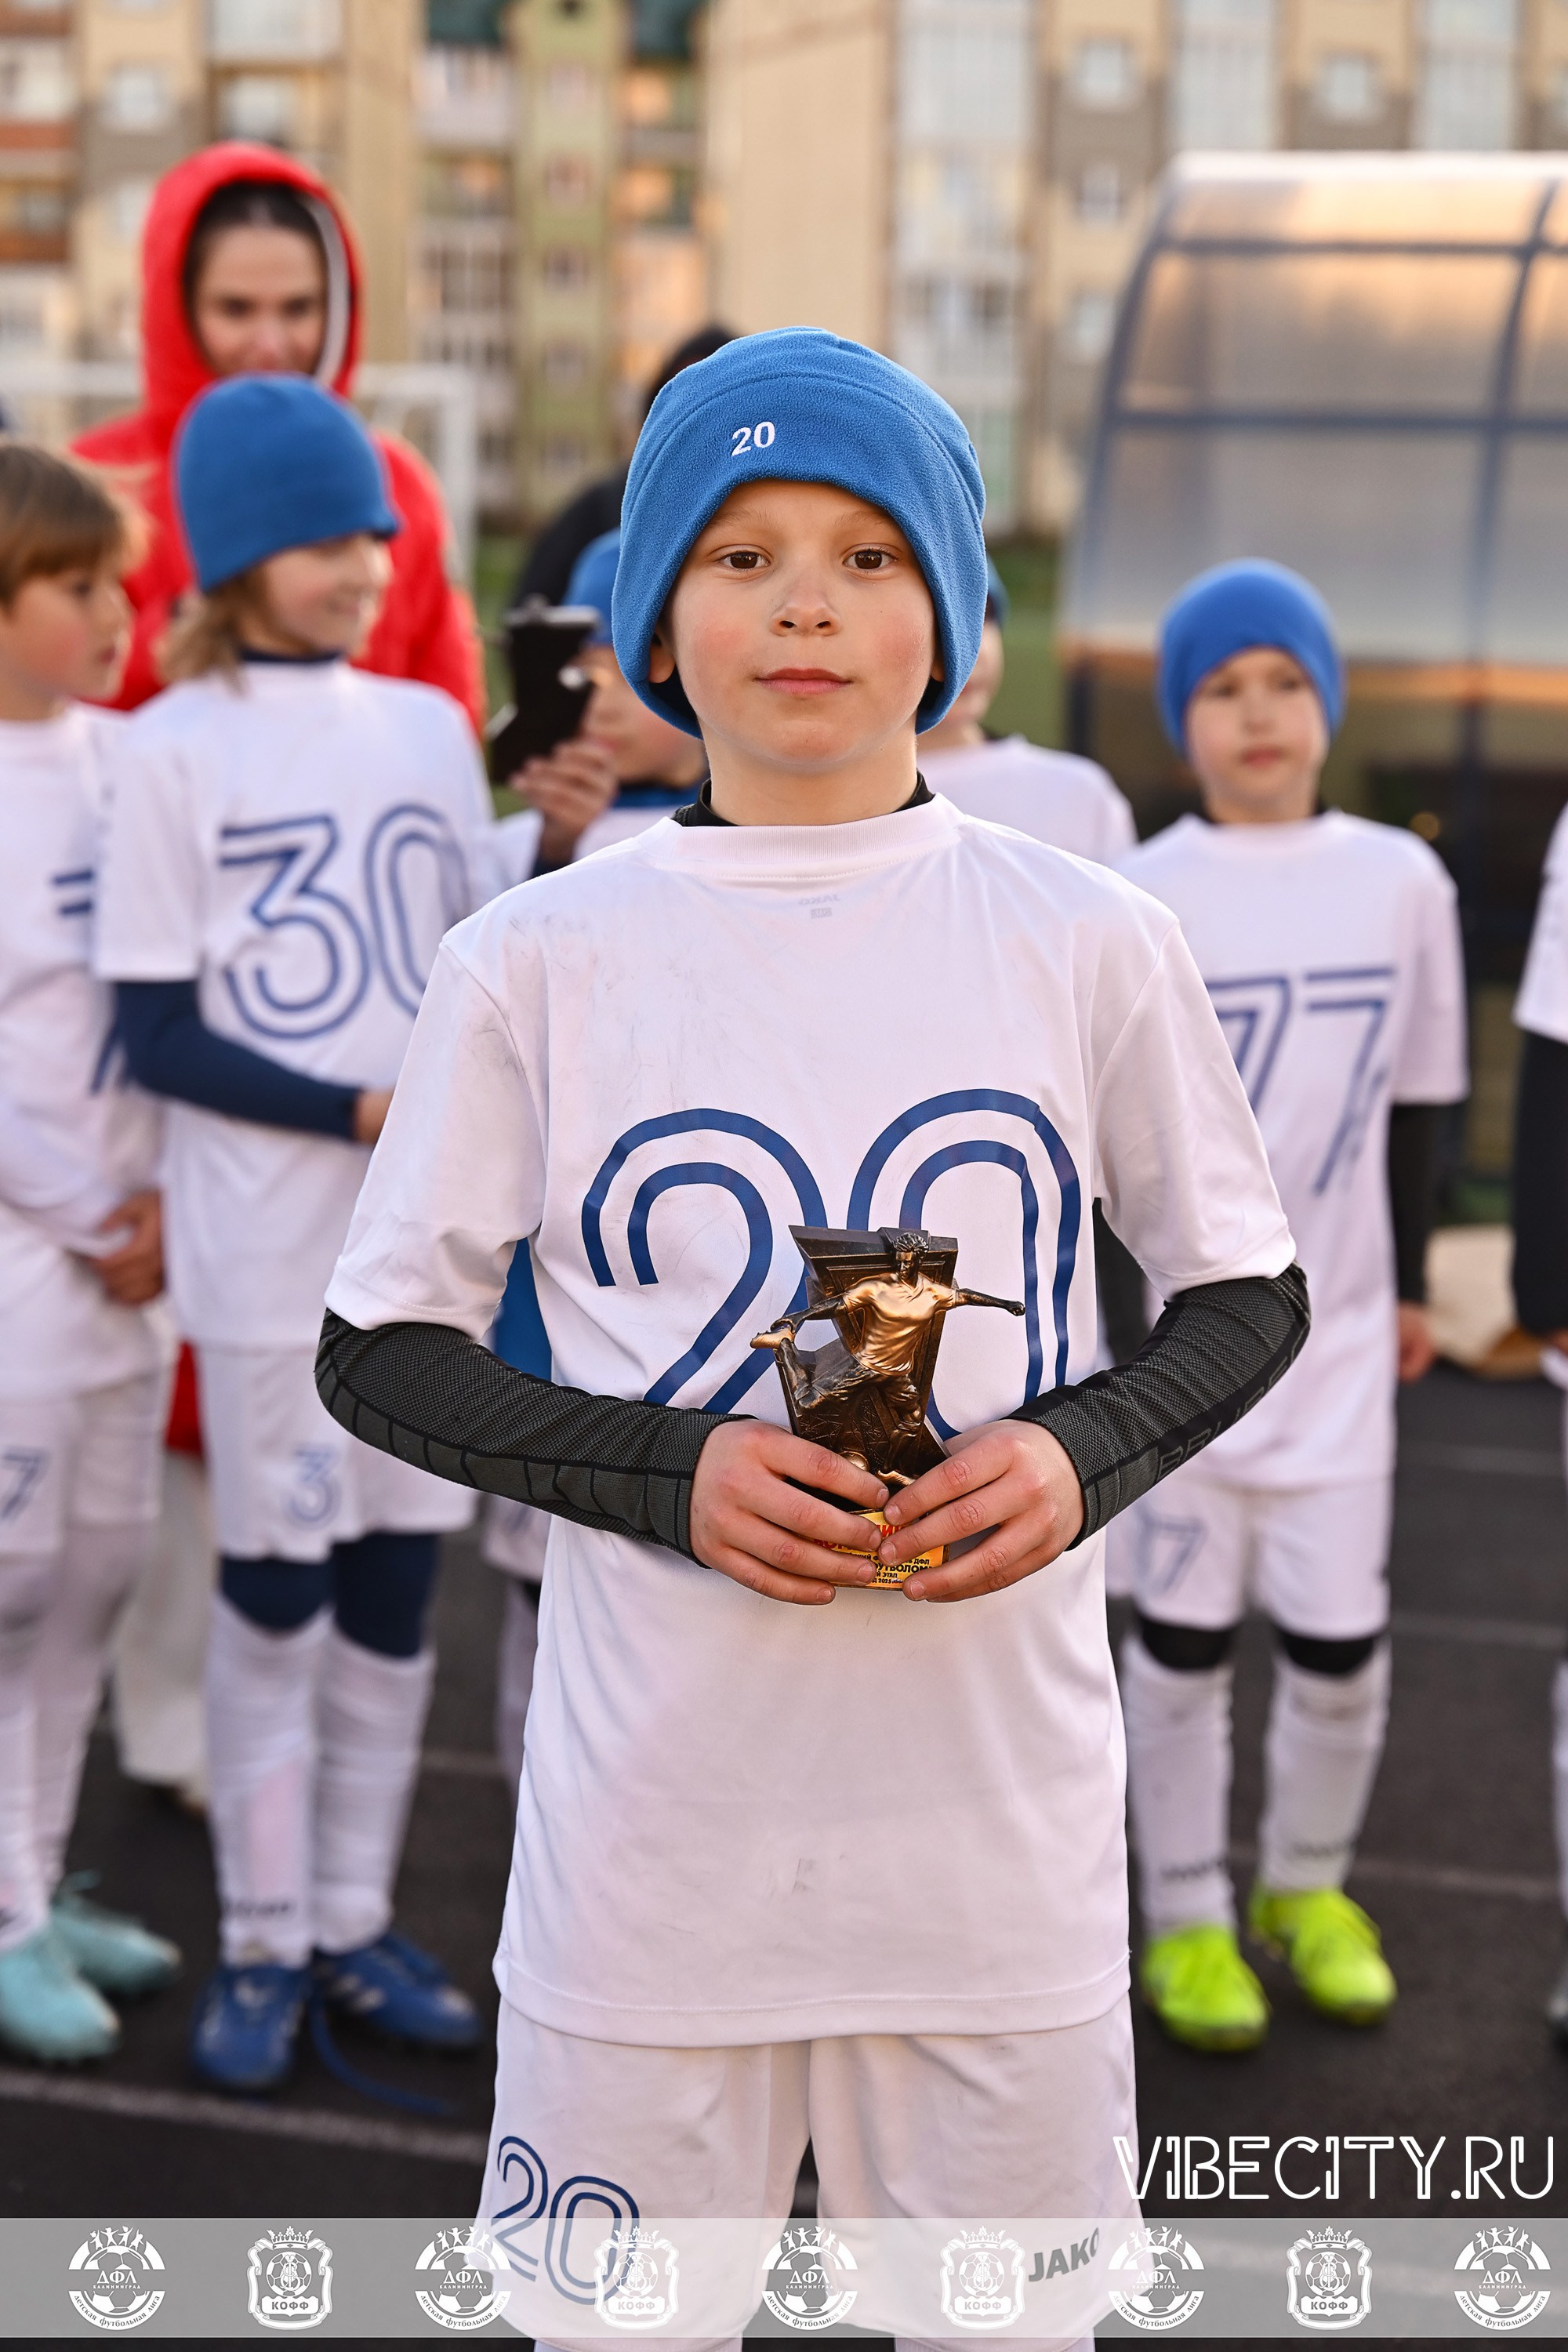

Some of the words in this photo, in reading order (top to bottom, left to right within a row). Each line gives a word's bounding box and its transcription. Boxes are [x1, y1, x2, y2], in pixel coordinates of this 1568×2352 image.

[731, 421, 775, 456] 20
[218, 803, 472, 1040] 30
[582, 1088, 1082, 1439] 20
[492, 2136, 640, 2306] 20
